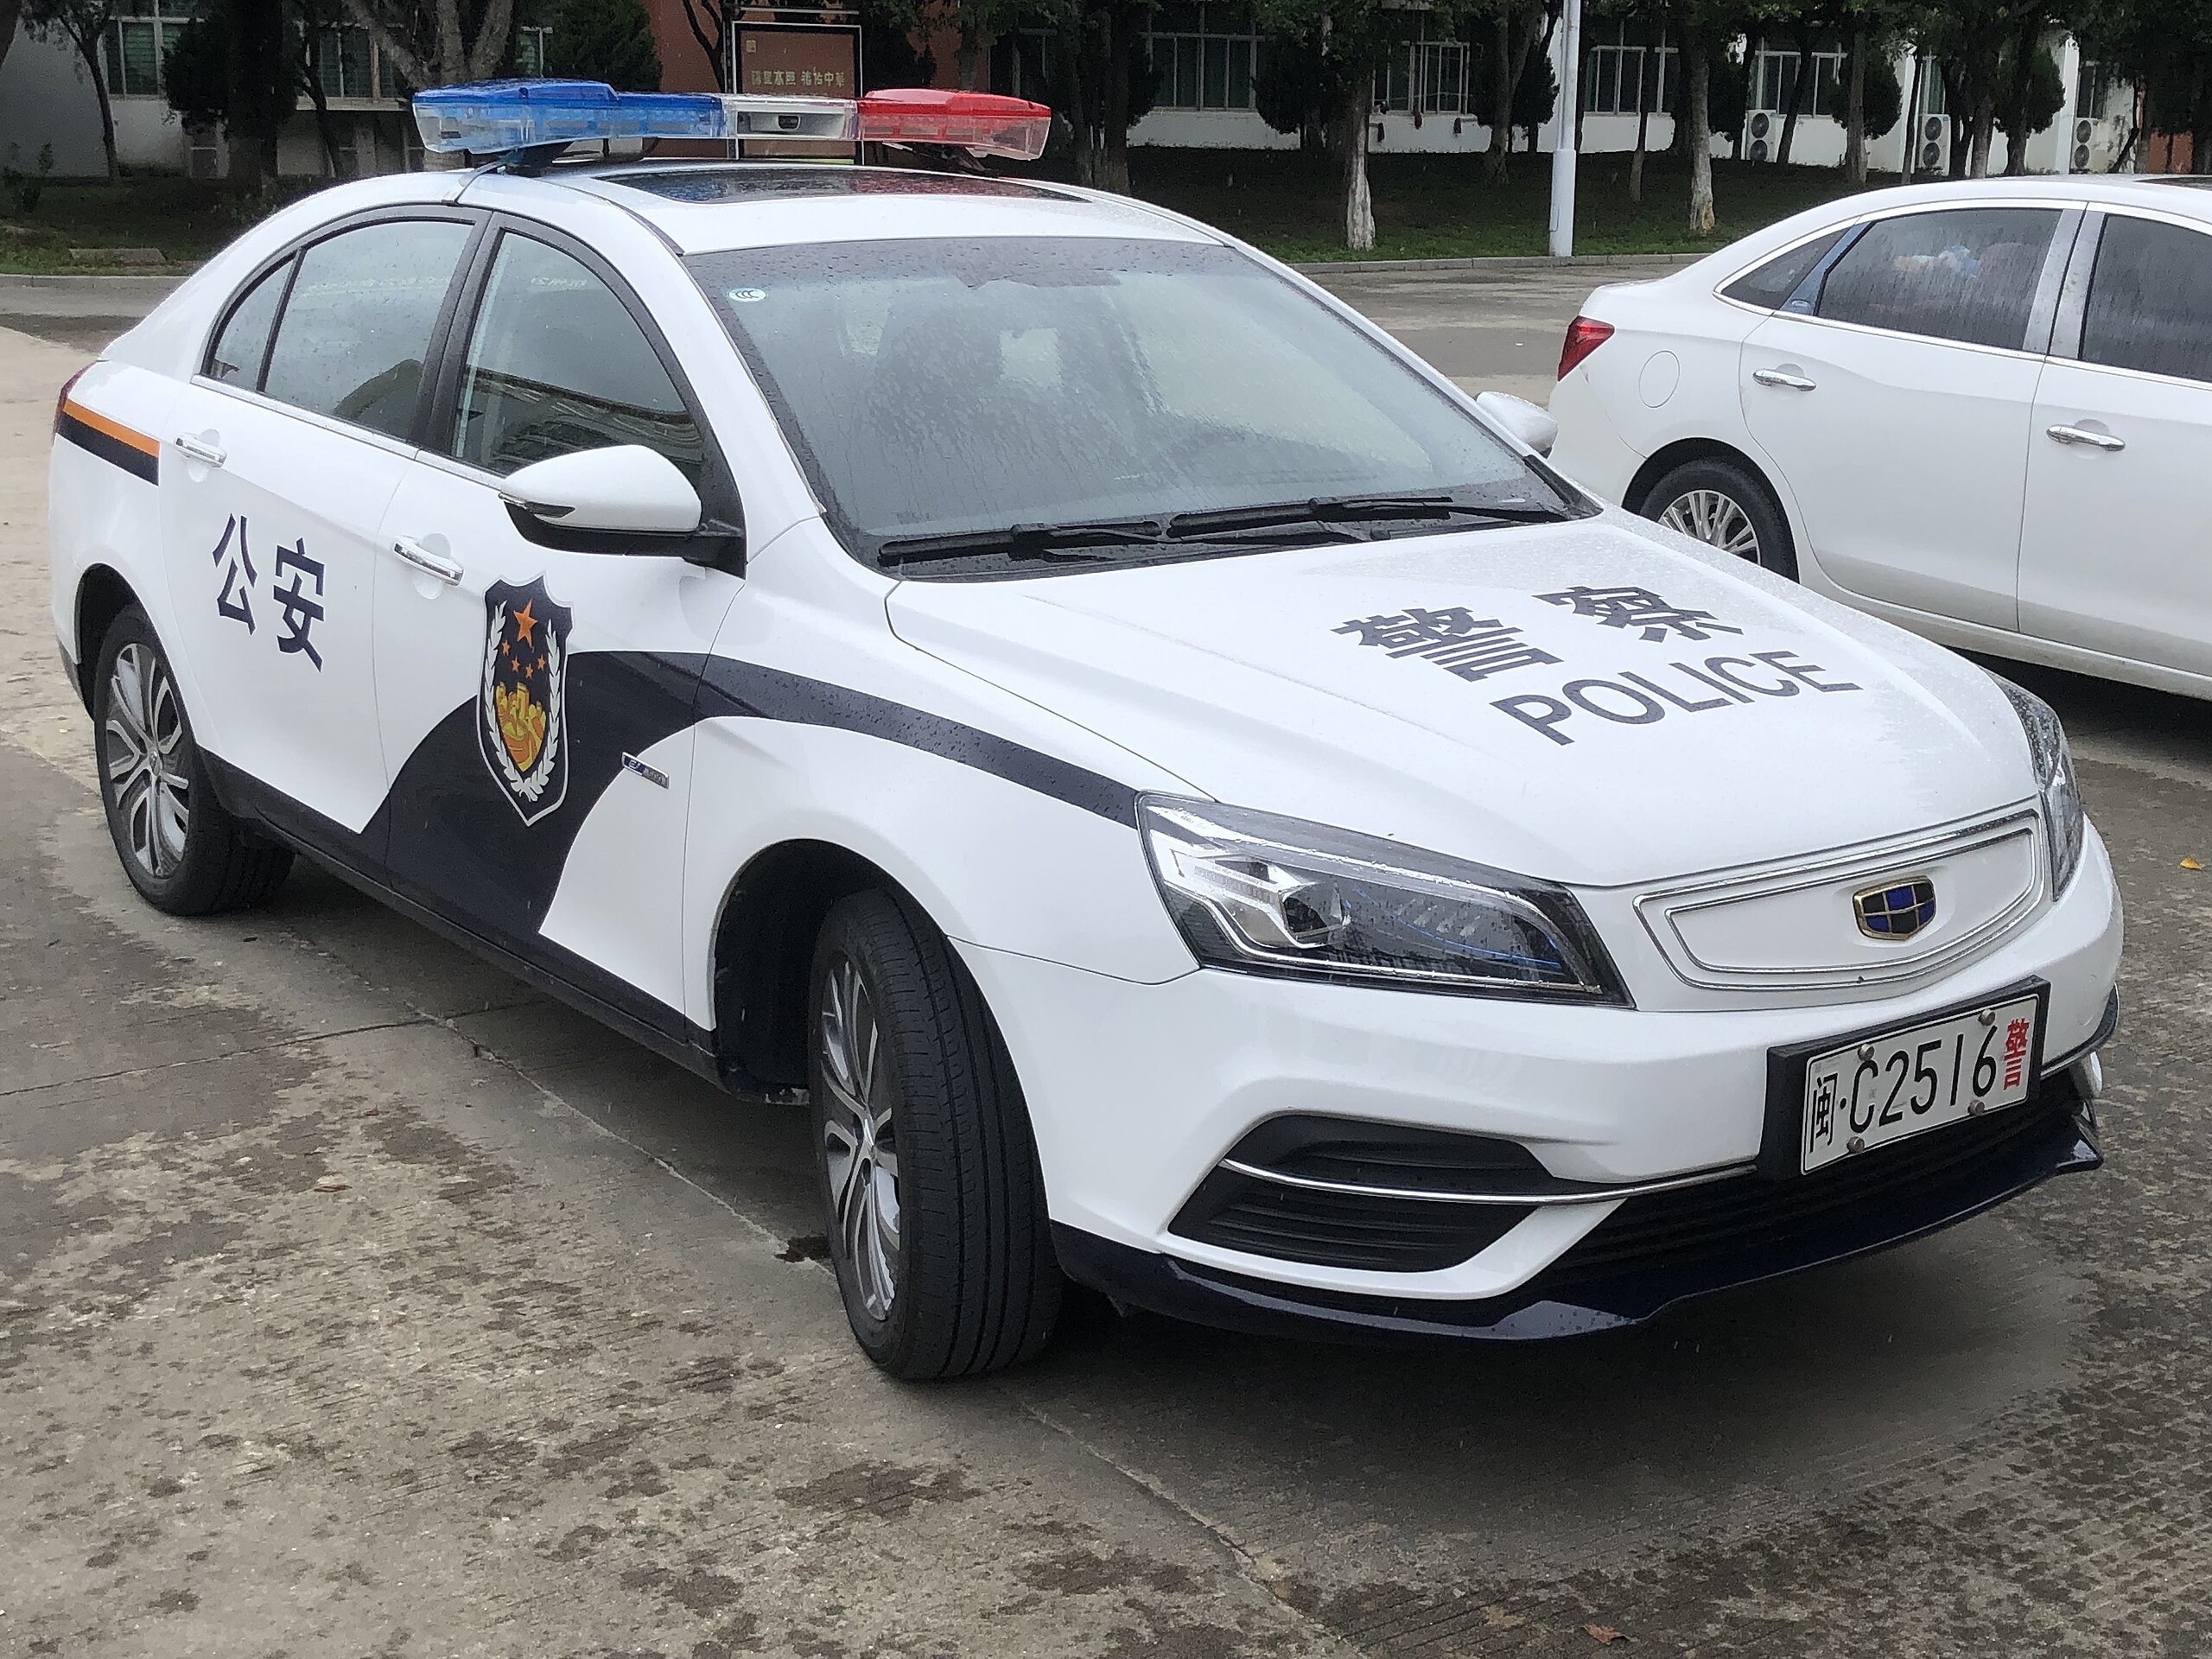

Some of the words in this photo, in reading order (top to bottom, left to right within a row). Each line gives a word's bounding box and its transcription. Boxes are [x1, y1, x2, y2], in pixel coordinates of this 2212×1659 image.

[213, 512, 325, 673] 公安
[1330, 586, 1744, 682] 警察
[1489, 650, 1864, 746] POLICE
